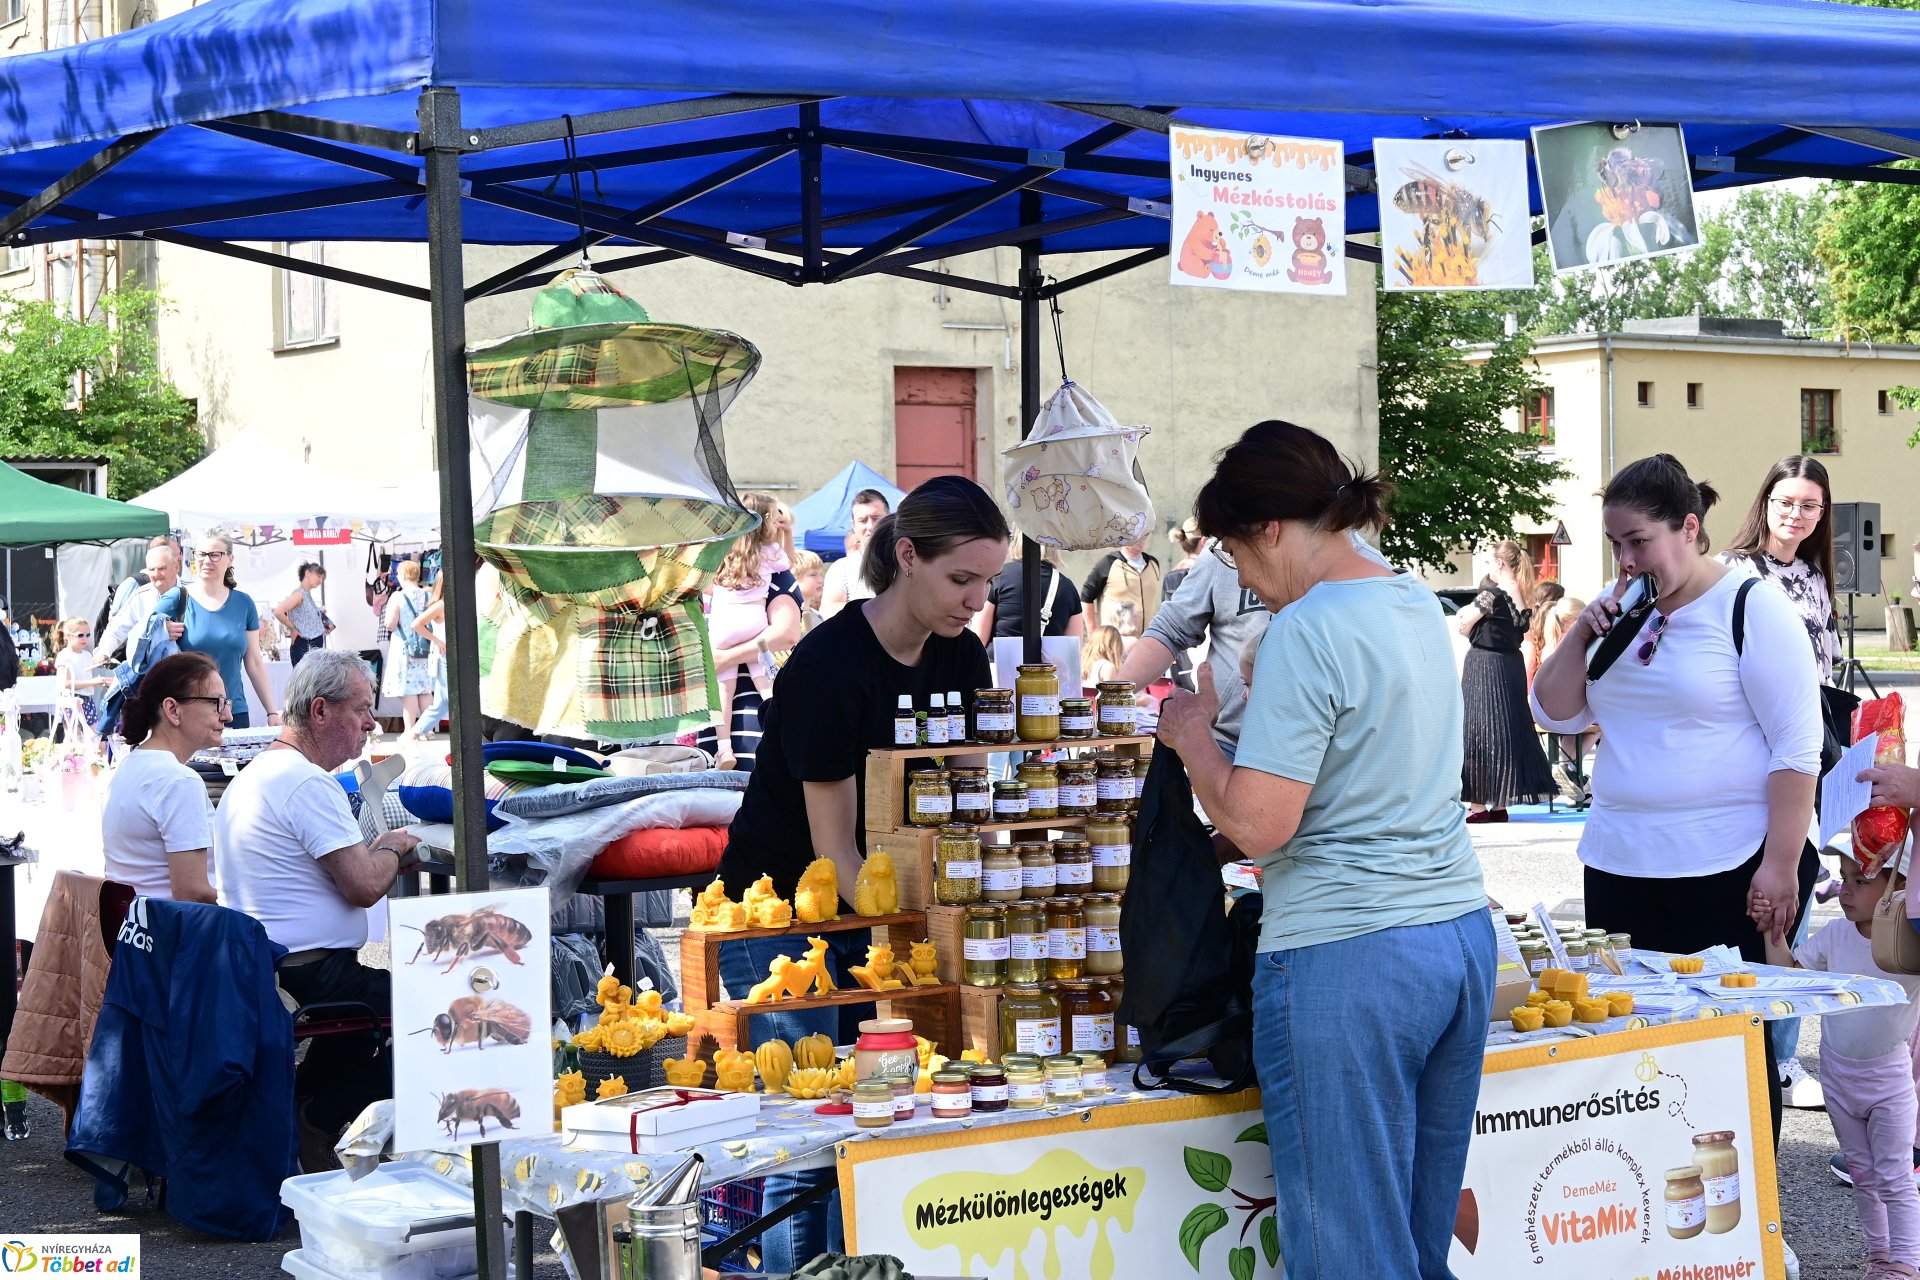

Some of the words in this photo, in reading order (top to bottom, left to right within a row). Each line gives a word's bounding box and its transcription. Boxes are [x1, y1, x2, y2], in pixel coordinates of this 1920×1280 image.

[1190, 164, 1253, 183] Ingyenes
[1213, 185, 1337, 212] Mézkóstolás
[1243, 266, 1263, 278] Deme
[1298, 268, 1322, 277] HONEY
[878, 1052, 901, 1068] bee
[1475, 1085, 1660, 1135] Immunerősítés
[1594, 1137, 1615, 1153] álló
[1539, 1137, 1592, 1181] termékből
[1616, 1143, 1646, 1189] komplex
[916, 1172, 1127, 1231] Mézkülönlegességek
[1562, 1179, 1617, 1199] DemeMéz
[1524, 1181, 1544, 1254] méhészeti
[1541, 1202, 1638, 1246] VitaMix
[1640, 1187, 1651, 1244] keverék
[1532, 1255, 1544, 1265] 6
[1656, 1256, 1756, 1280] Méhkenyér
